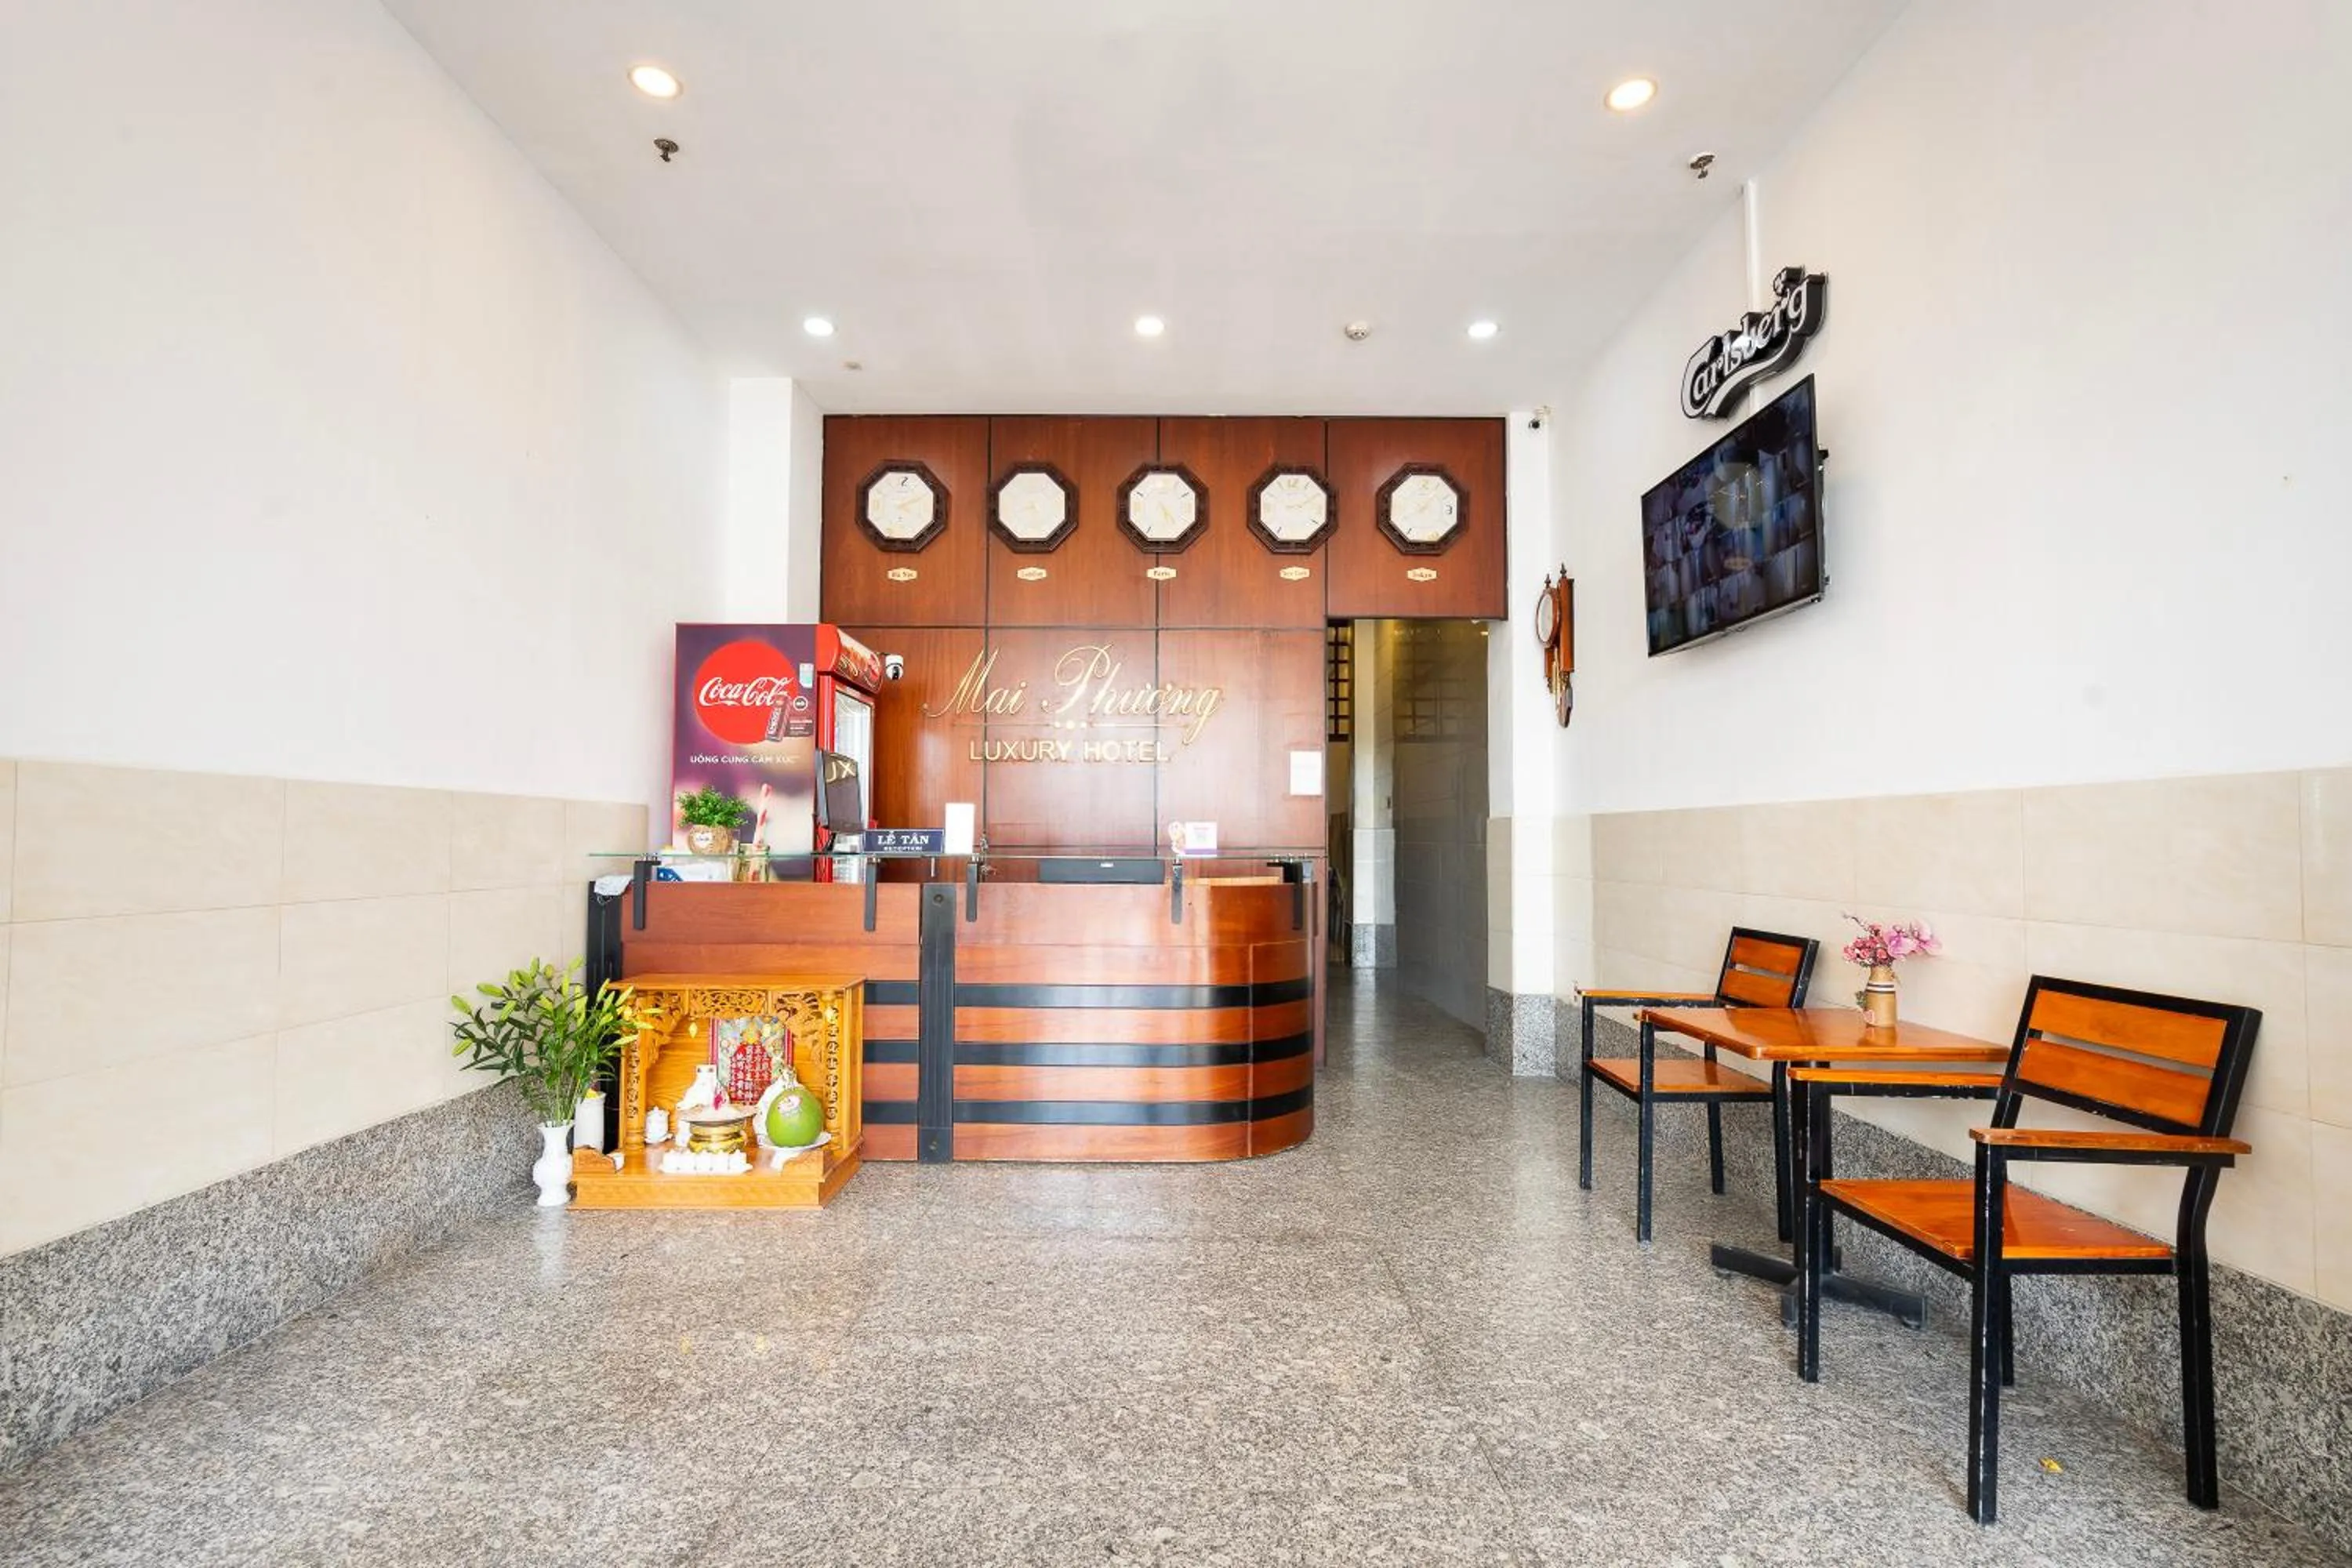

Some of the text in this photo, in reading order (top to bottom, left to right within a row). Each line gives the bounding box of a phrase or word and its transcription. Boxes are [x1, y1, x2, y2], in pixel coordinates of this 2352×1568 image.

[1681, 278, 1809, 418] Carlsberg
[699, 677, 794, 706] Coca-Col
[923, 645, 1028, 719] Mai
[969, 739, 1171, 763] LUXURY HOTEL
[901, 833, 929, 844] TÂN
